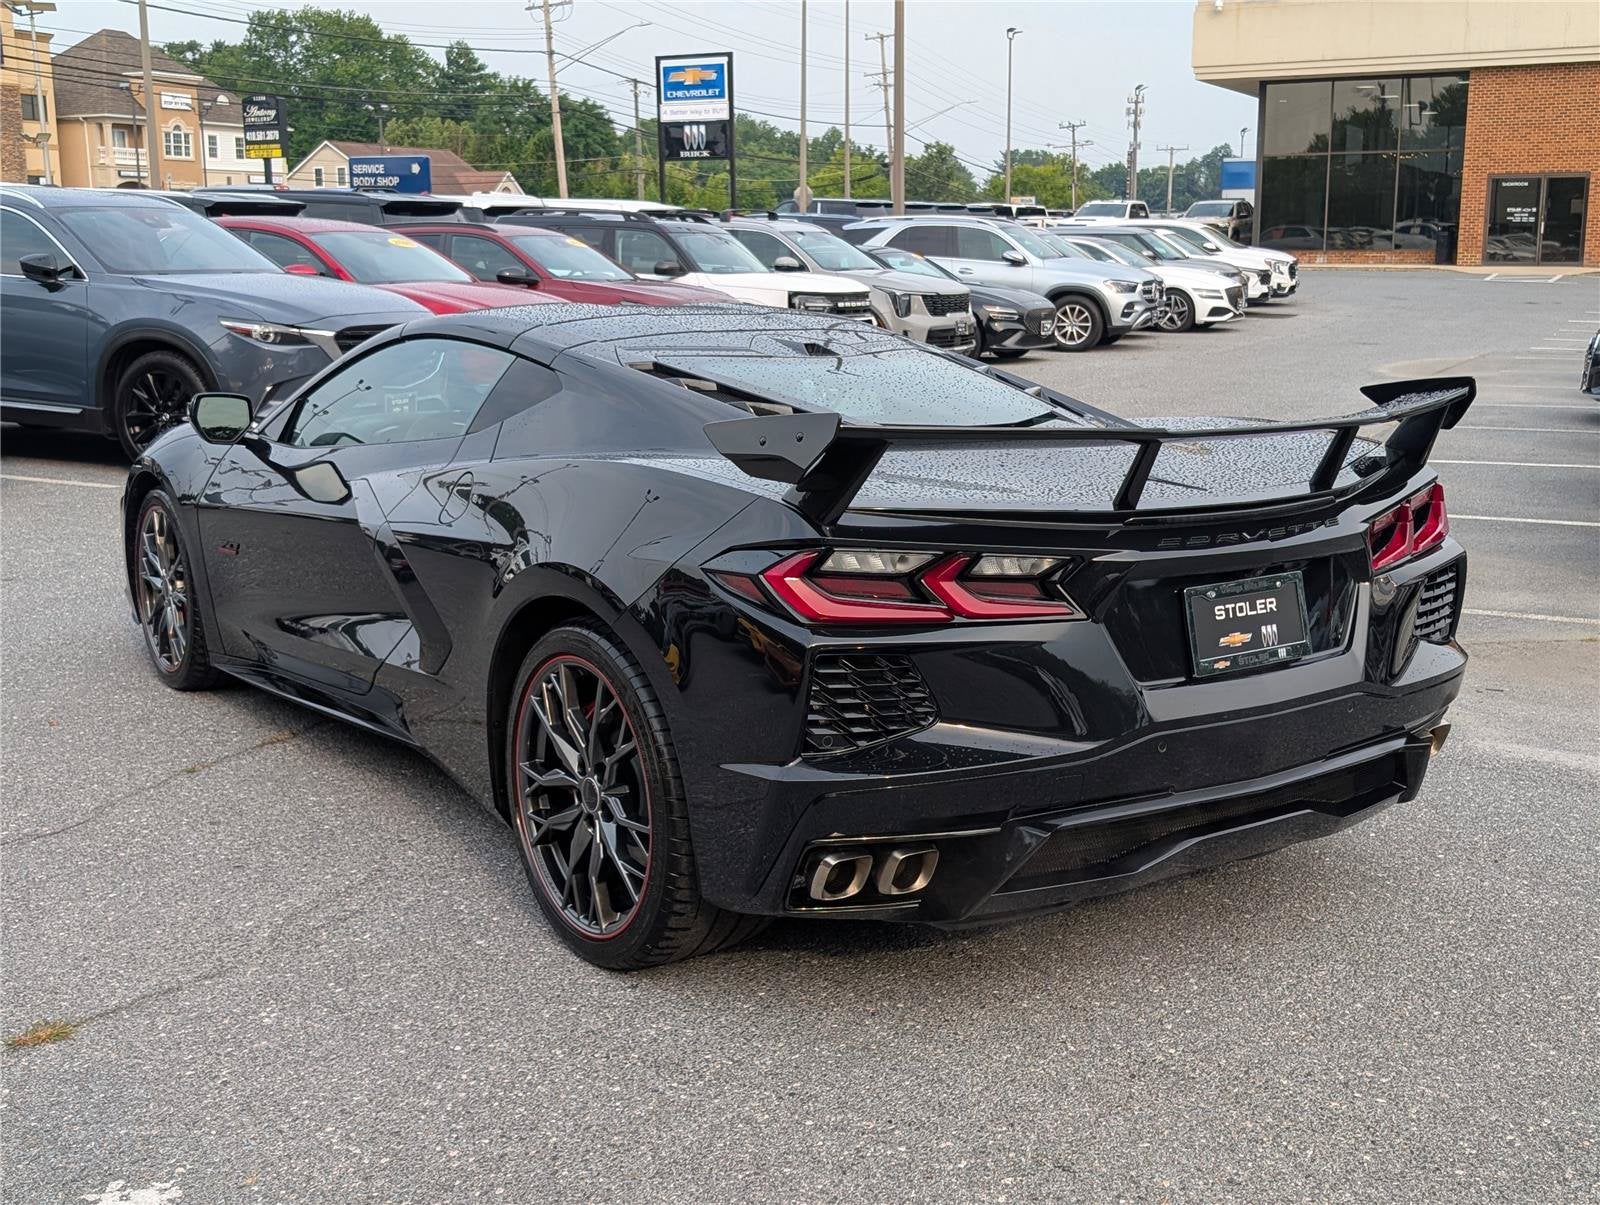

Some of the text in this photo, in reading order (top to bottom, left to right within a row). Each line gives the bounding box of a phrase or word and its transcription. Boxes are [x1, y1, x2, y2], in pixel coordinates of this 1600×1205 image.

[667, 89, 720, 98] CHEVROLET
[352, 164, 385, 174] SERVICE
[353, 176, 400, 187] BODY SHOP
[1157, 516, 1340, 547] CORVETTE
[1214, 597, 1277, 621] STOLER
